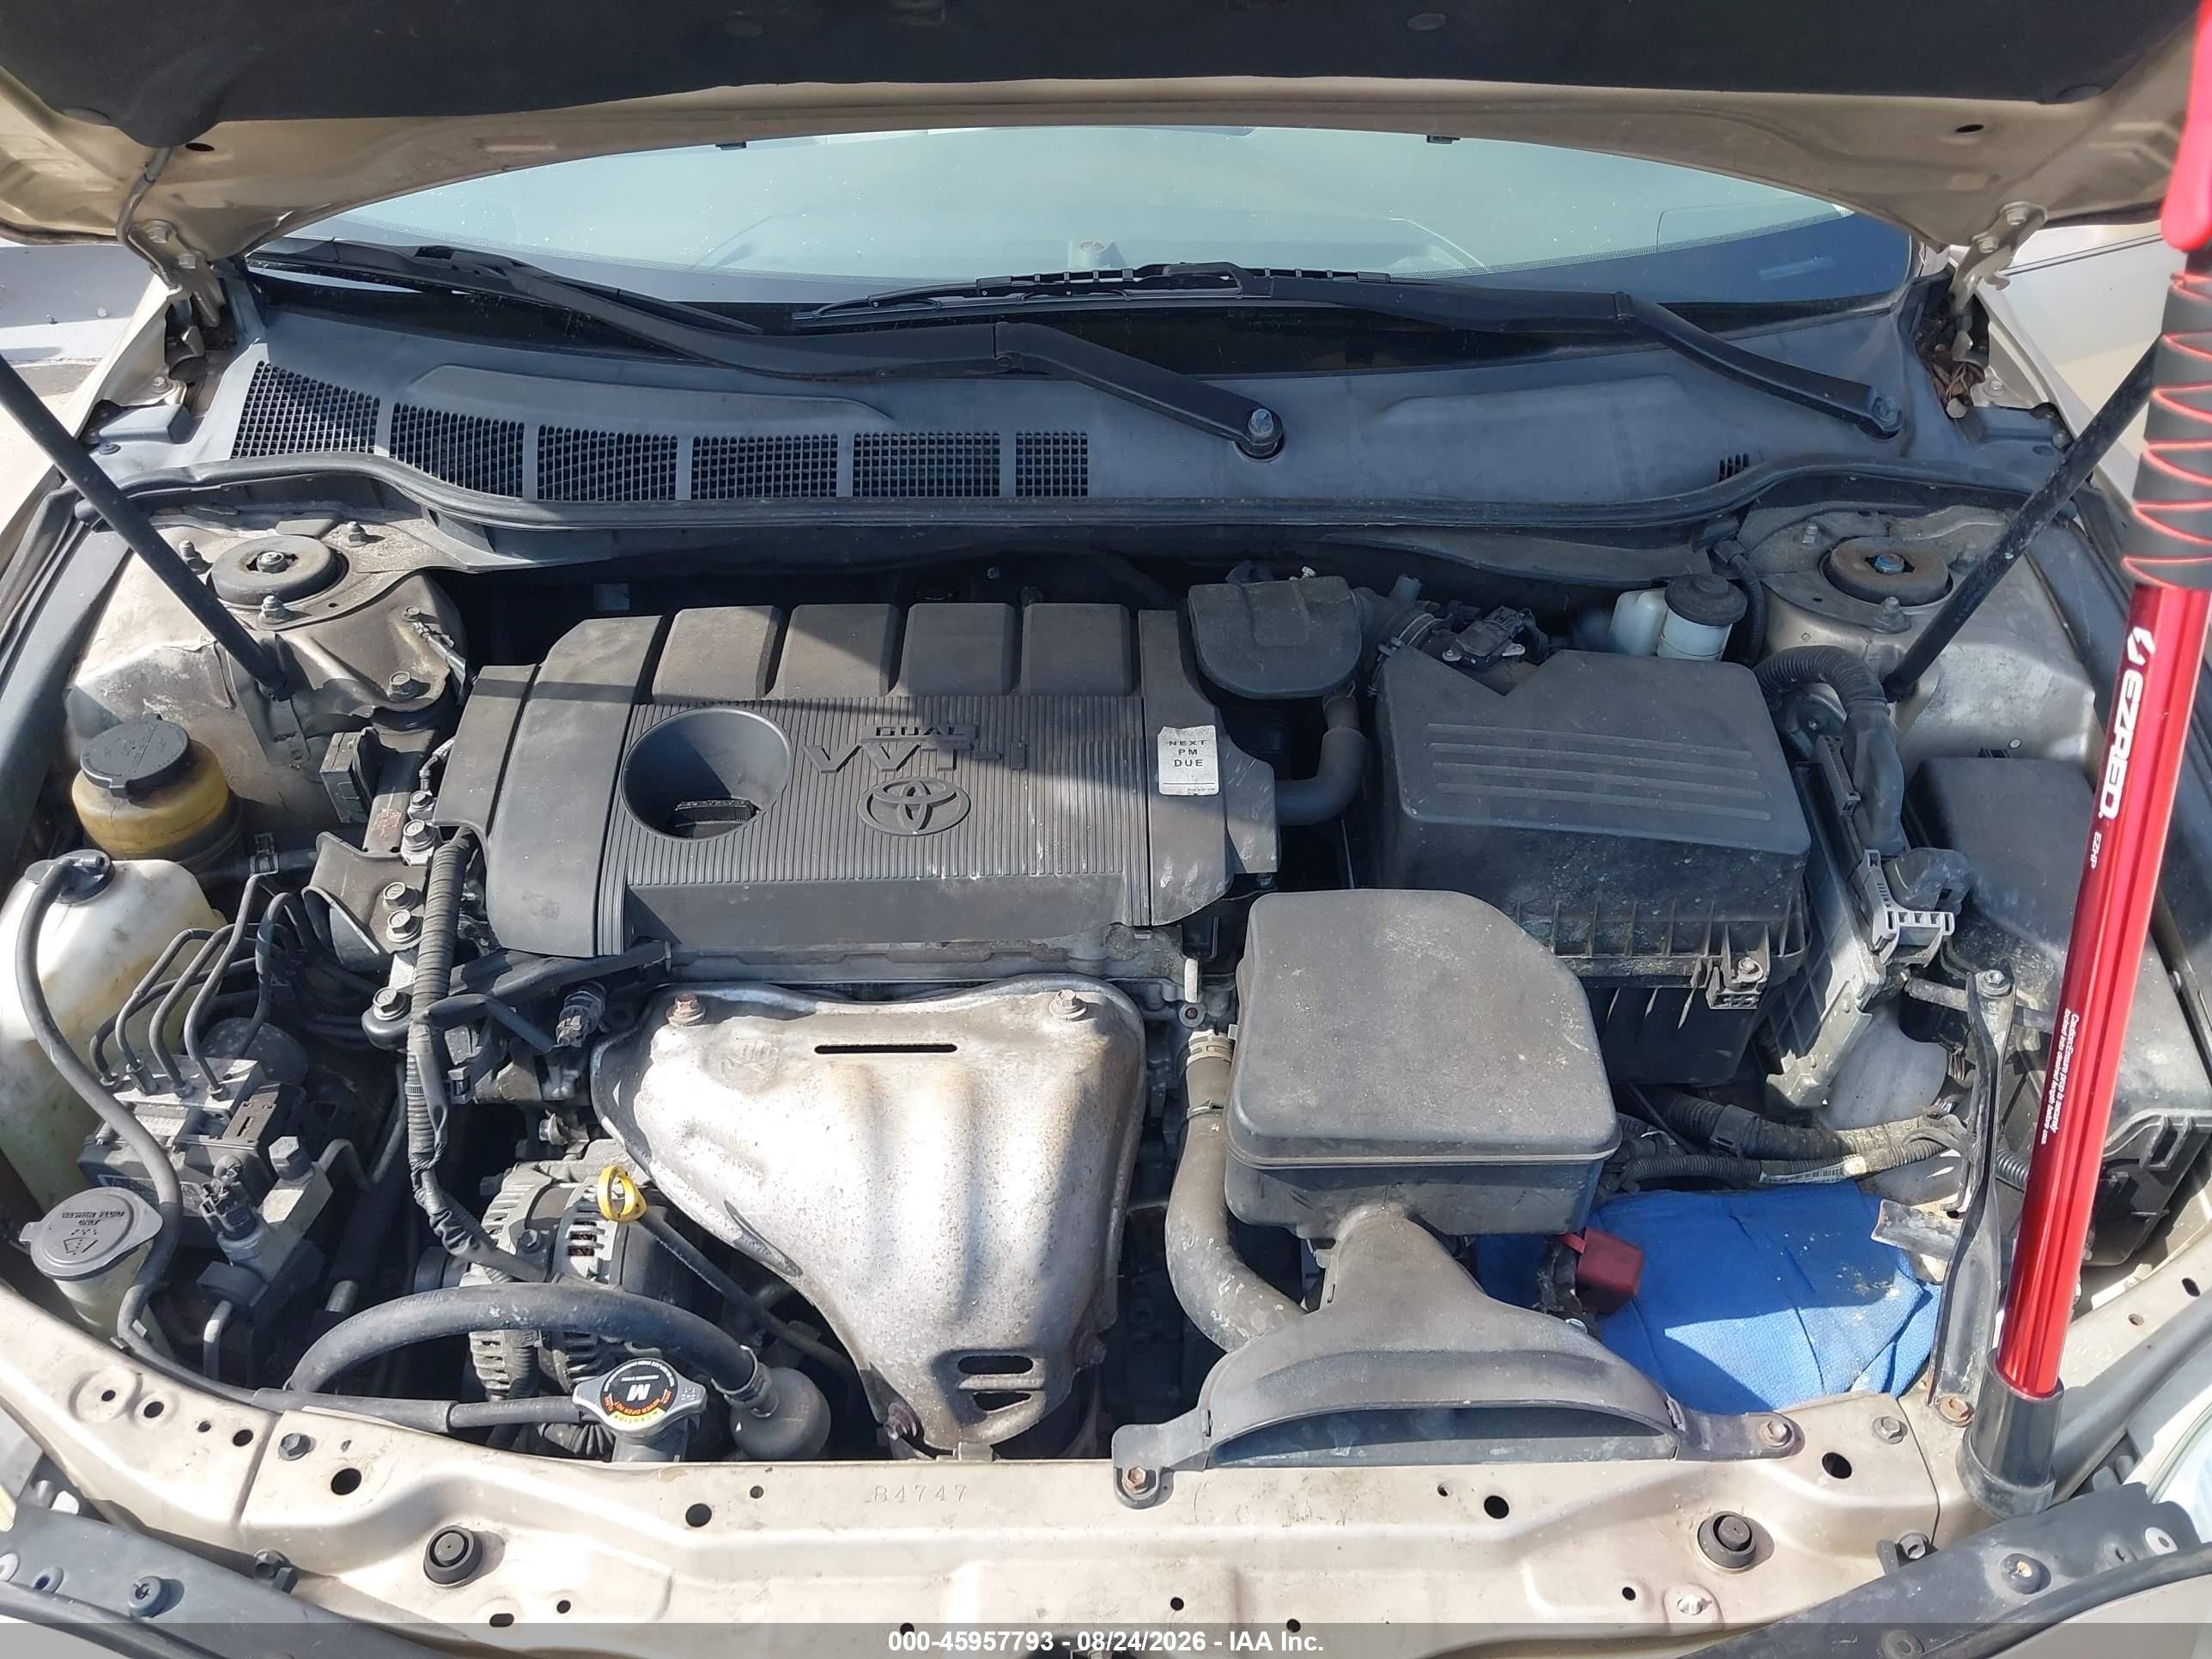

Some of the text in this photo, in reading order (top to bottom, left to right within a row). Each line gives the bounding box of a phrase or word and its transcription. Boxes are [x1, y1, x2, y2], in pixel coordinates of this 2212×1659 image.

[875, 724, 969, 738] DUAL
[2089, 831, 2102, 869] EZHP
[2060, 1008, 2071, 1036] locked
[2053, 1051, 2063, 1079] desired
[2047, 1080, 2057, 1104] length
[2057, 1073, 2067, 1092] prop
[2044, 1104, 2053, 1129] before
[2050, 1100, 2063, 1133] securely
